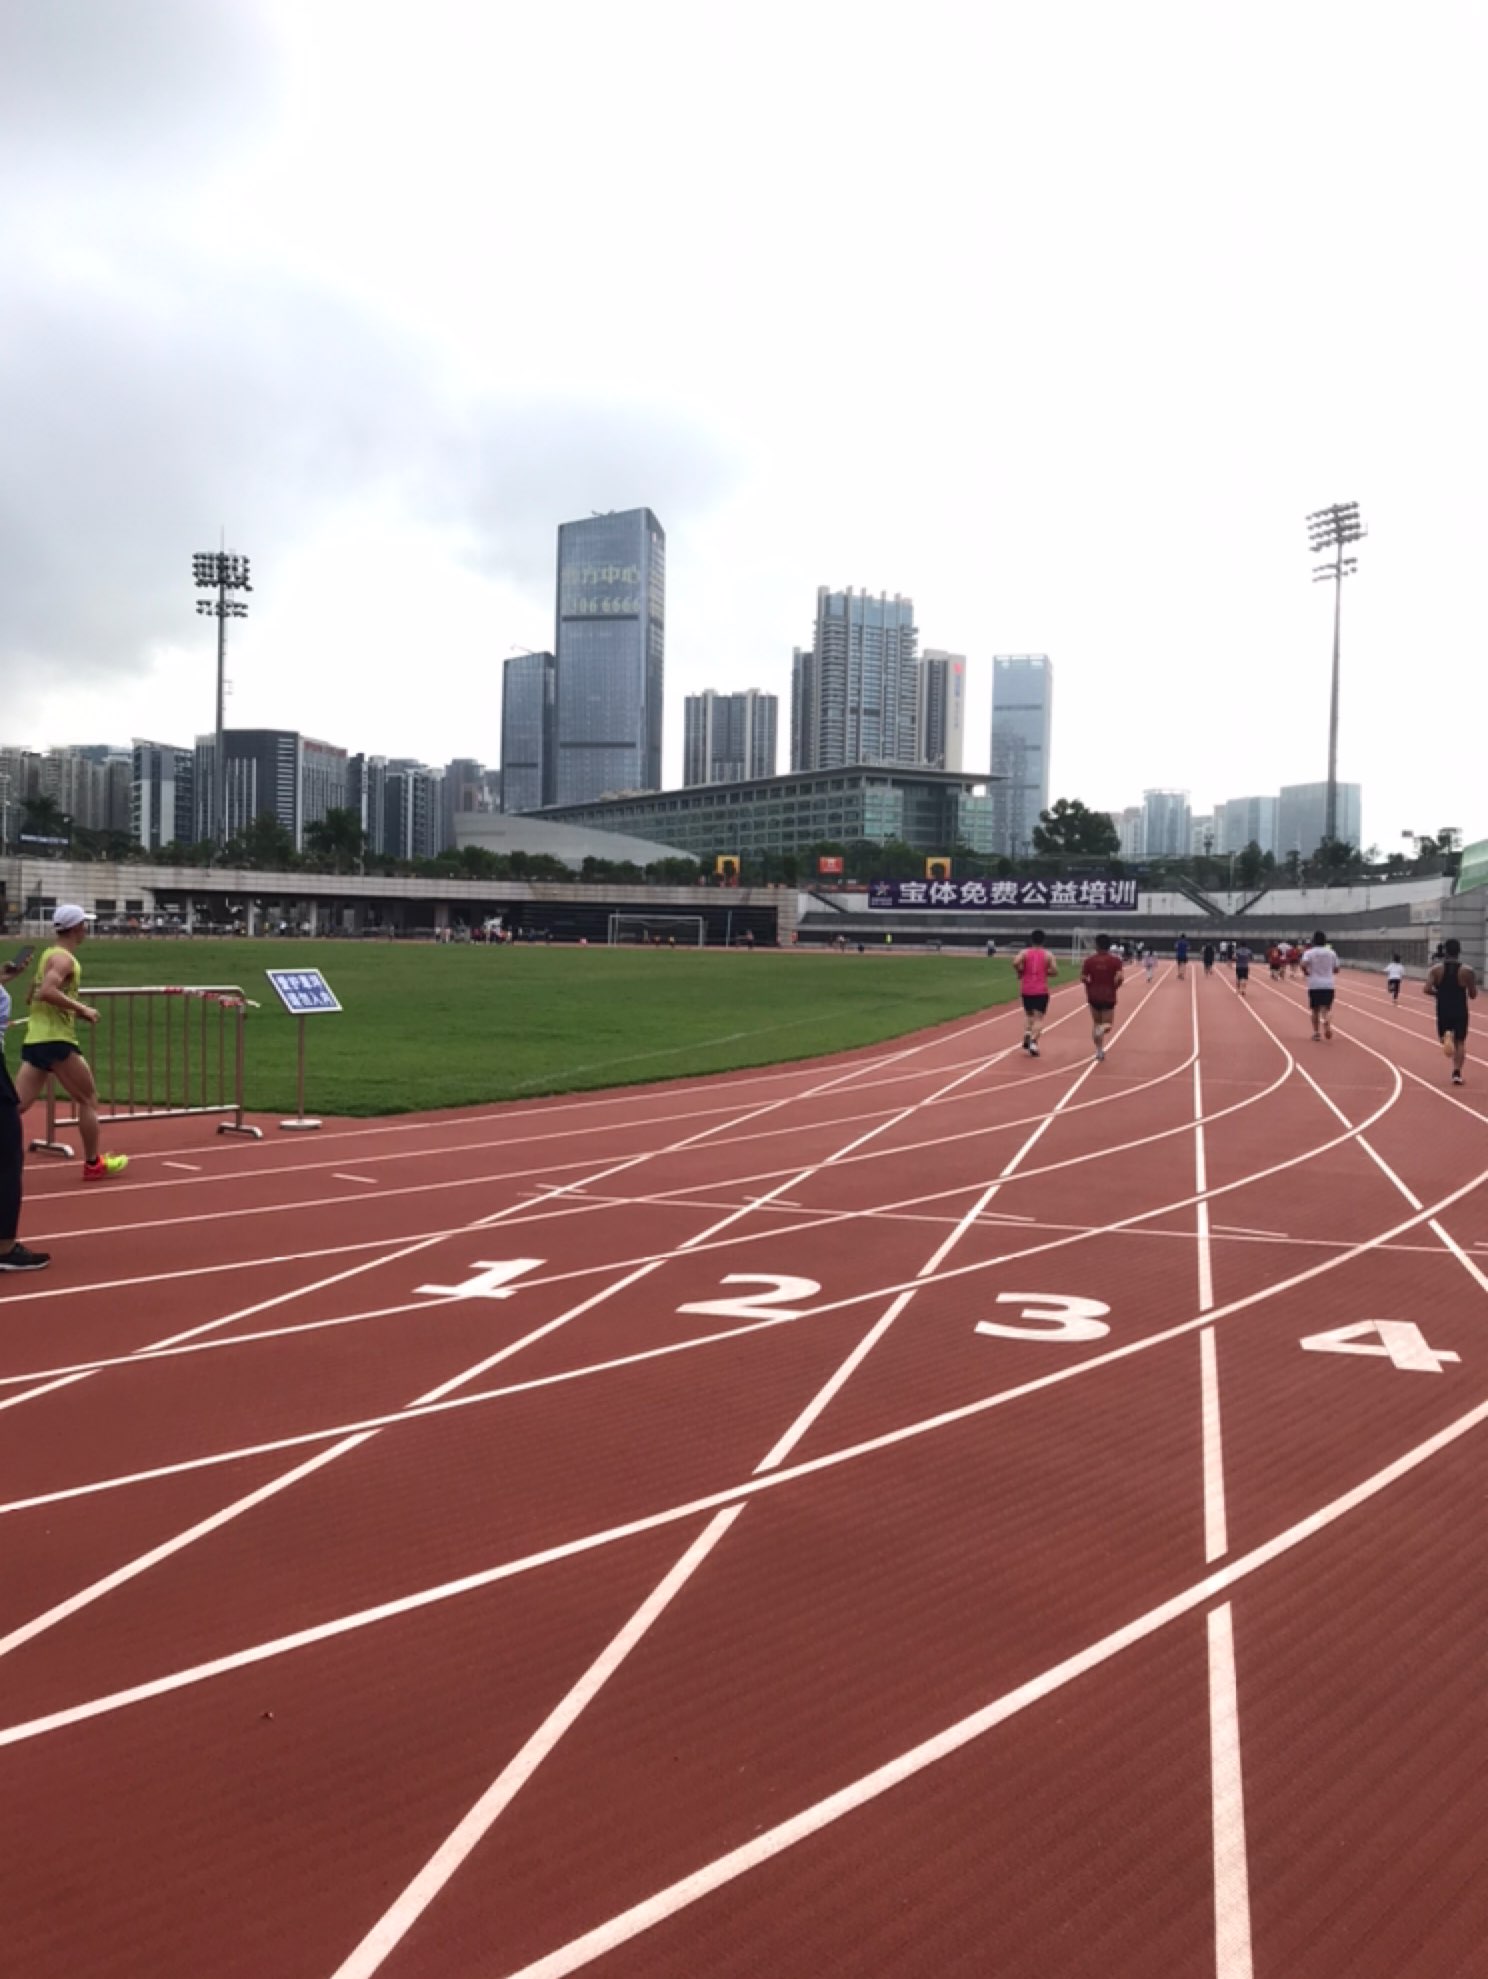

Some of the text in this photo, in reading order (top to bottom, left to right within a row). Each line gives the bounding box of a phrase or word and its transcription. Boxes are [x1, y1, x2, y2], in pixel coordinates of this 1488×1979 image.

[898, 880, 1136, 904] 宝体免费公益培训
[411, 1258, 547, 1299] 1
[674, 1273, 821, 1320] 2
[974, 1293, 1110, 1341] 3
[1299, 1319, 1461, 1372] 4
